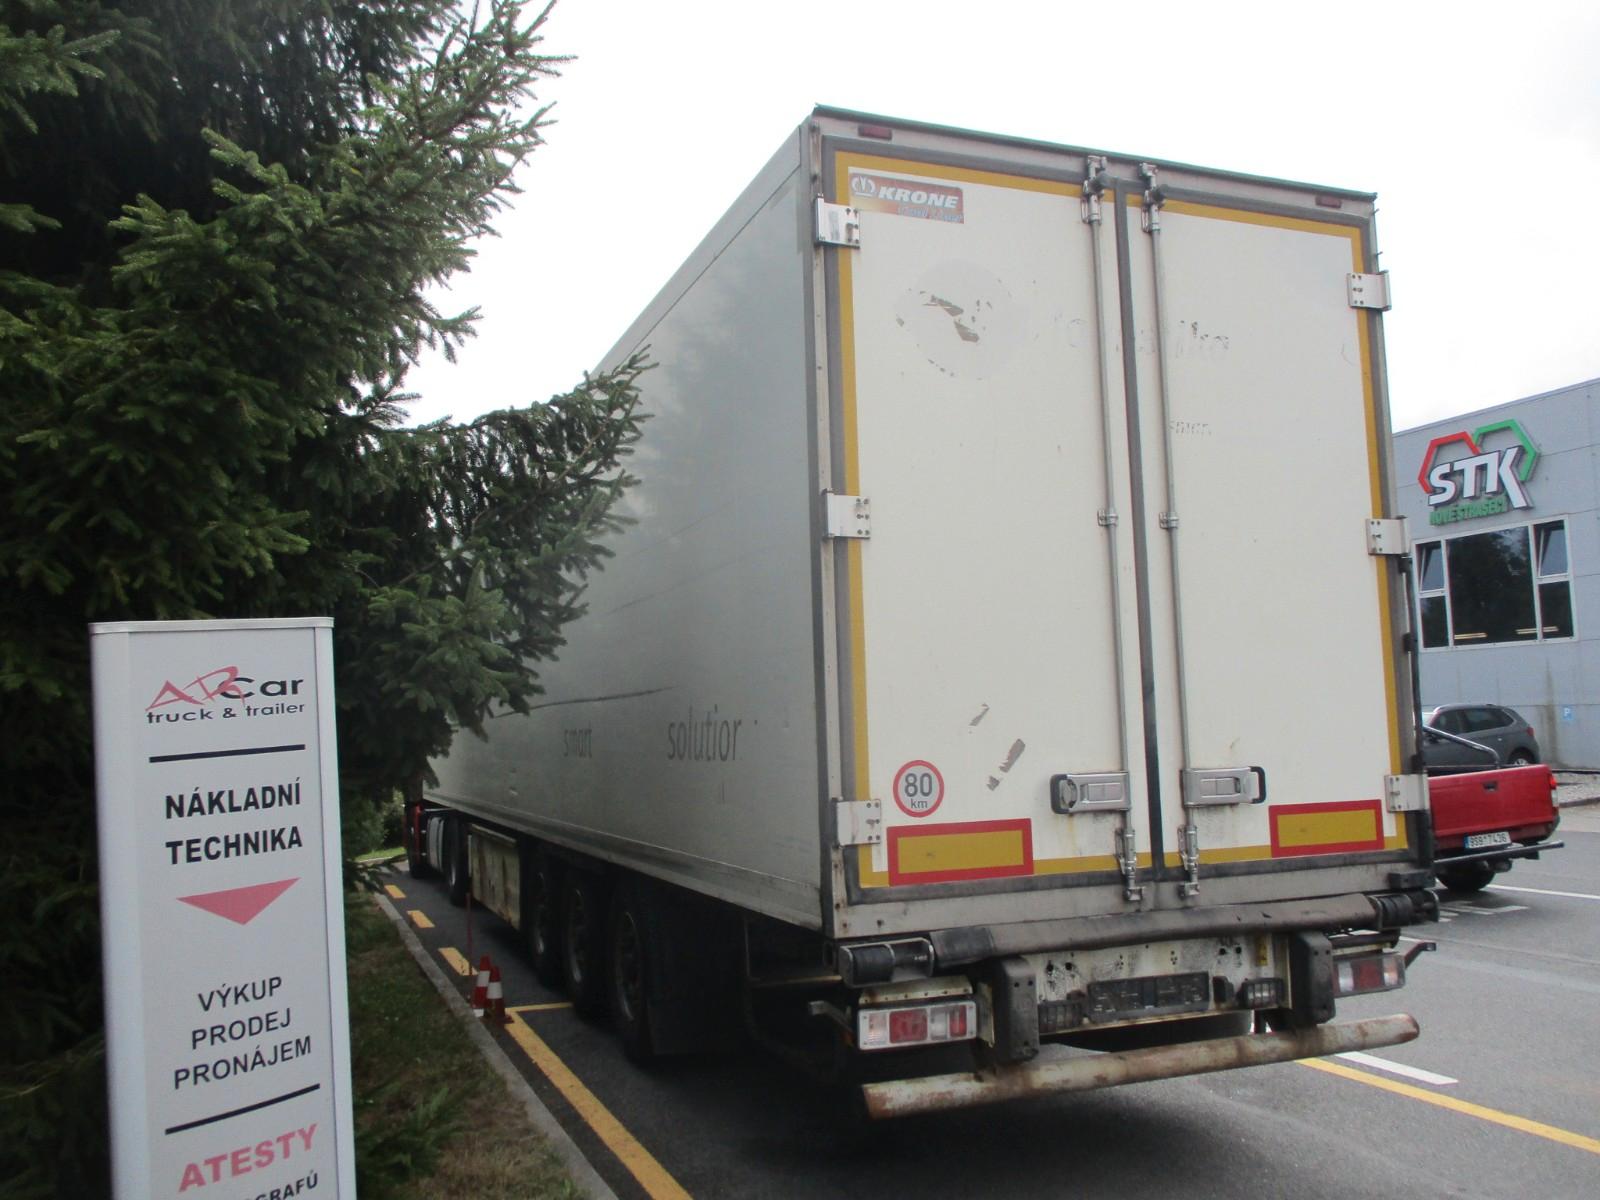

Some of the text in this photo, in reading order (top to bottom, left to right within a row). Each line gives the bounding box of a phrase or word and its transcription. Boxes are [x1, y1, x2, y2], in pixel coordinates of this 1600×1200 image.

[878, 185, 960, 209] KRONE
[1428, 446, 1529, 509] STK
[146, 703, 305, 724] truck & trailer
[165, 777, 301, 819] NÁKLADNÍ
[904, 773, 932, 797] 80
[910, 798, 928, 809] km
[165, 826, 303, 865] TECHNIKA
[198, 976, 282, 1012] VÝKUP
[192, 1008, 291, 1050] PRODEJ
[174, 1036, 312, 1090] PRONÁJEM
[178, 1123, 318, 1192] ATESTY
